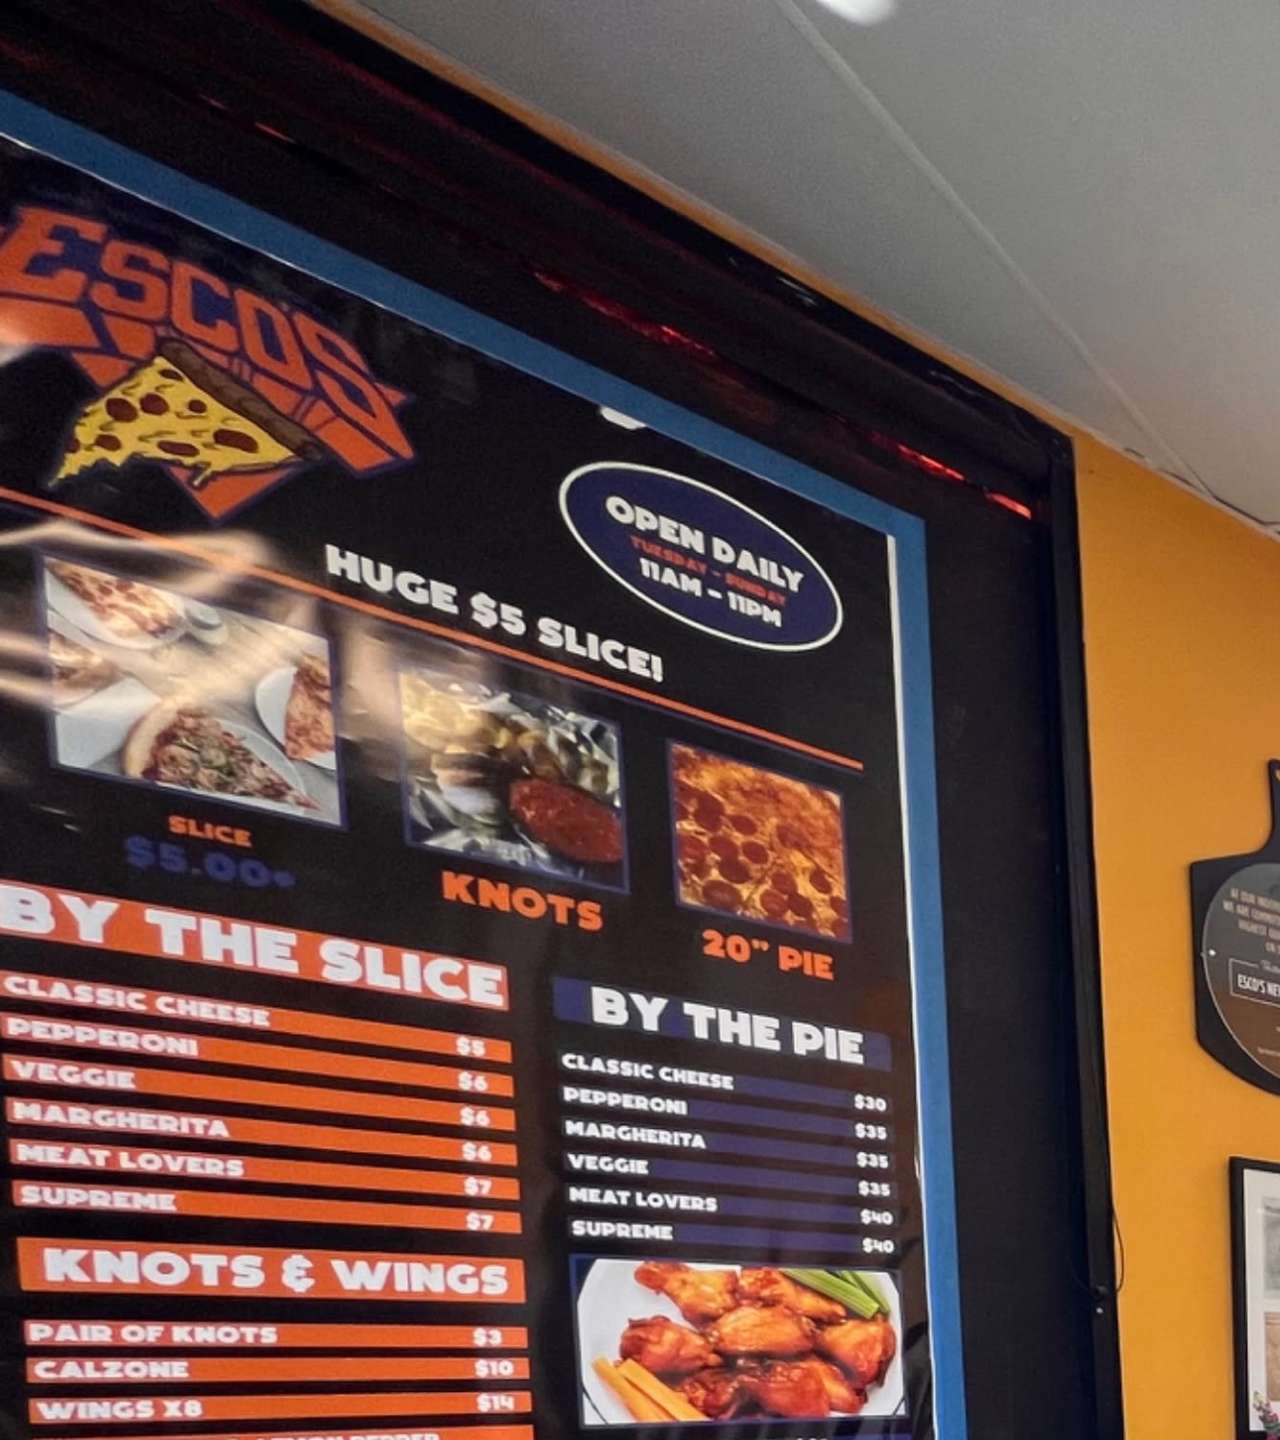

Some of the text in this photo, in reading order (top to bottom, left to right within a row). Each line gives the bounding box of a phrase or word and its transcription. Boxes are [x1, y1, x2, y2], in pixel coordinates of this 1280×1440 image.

[605, 495, 804, 592] OPEN DAILY
[630, 535, 707, 576] TUESDAY
[725, 571, 786, 606] SUNDAY
[323, 544, 665, 682] HUGE $5 SLICE!
[640, 557, 702, 597] 11AM
[727, 591, 782, 628] 11PM
[168, 814, 252, 847] SLICE
[440, 870, 603, 931] KNOTS
[0, 885, 505, 1007] BY THE SLICE
[778, 946, 835, 980] PIE
[3, 976, 486, 1058] CLASSIC CHEESE $5
[591, 986, 864, 1065] BY THE PIE
[6, 1017, 487, 1093] PEPPERONI $6
[10, 1060, 490, 1128] VEGGIE $6
[562, 1053, 887, 1112] CLASSIC CHEESE $30
[13, 1102, 493, 1163] MARGHERITA $6
[563, 1086, 887, 1140] PEPPERONI $35
[16, 1144, 493, 1198] MEAT LOVERS $7
[565, 1120, 889, 1169] MARGHERITA $35
[567, 1153, 891, 1198] VEGGIE $35
[20, 1185, 494, 1232] SUPREME $7
[568, 1186, 893, 1225] MEAT LOVERS $40
[571, 1219, 894, 1253] SUPREME $40
[43, 1248, 508, 1295] KNOTS & WINGS
[28, 1324, 502, 1347] PAIR OF KNOTS $3
[33, 1359, 514, 1379] CALZONE $10
[36, 1394, 515, 1420] WINGS X8 $14
